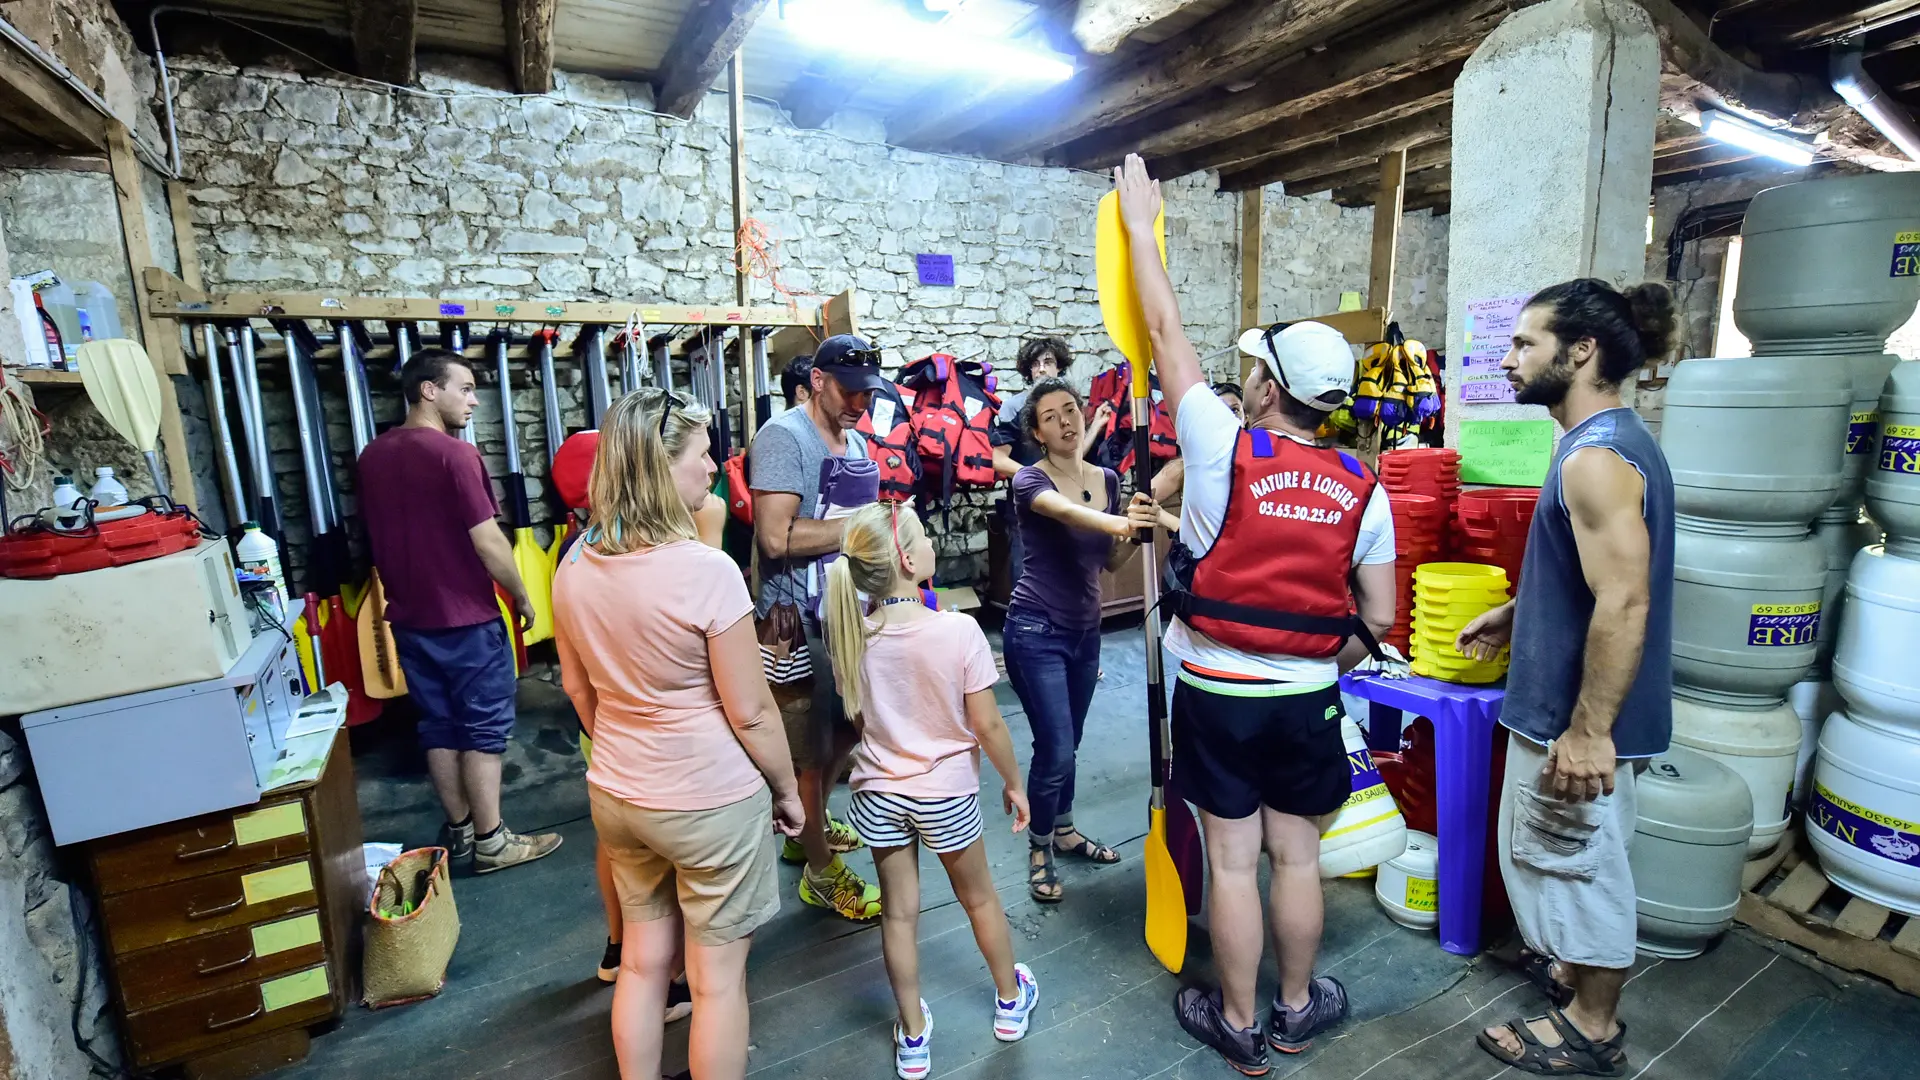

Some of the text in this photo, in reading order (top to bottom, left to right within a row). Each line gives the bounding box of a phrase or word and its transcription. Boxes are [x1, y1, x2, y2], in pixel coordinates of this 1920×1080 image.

[1900, 428, 1916, 436] 25
[1880, 450, 1920, 473] RE
[1249, 471, 1358, 512] NATURE & LOISIRS
[1258, 500, 1342, 524] 05.65.30.25.69
[1753, 625, 1814, 644] URE
[1347, 750, 1378, 776] NA
[1820, 789, 1912, 830] 46330 SAULIAC
